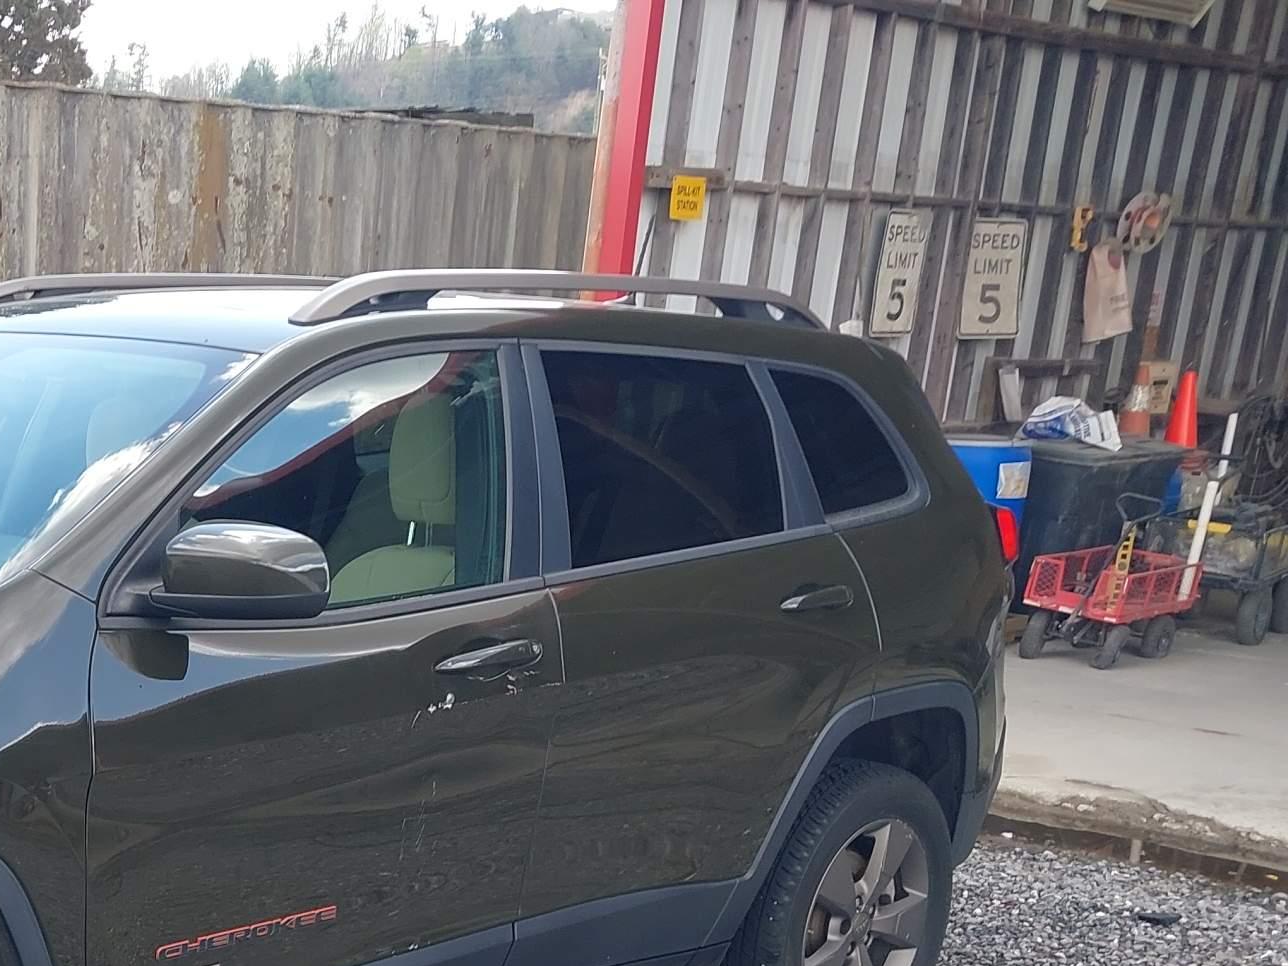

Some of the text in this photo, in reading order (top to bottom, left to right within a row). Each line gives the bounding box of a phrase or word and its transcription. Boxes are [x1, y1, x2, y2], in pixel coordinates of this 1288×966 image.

[888, 224, 927, 244] SPEED
[971, 233, 1021, 250] SPEED
[886, 252, 919, 269] LIMIT
[973, 257, 1013, 275] LIMIT
[886, 278, 907, 321] 5
[977, 283, 1002, 324] 5
[155, 905, 337, 961] CHEROKEE
